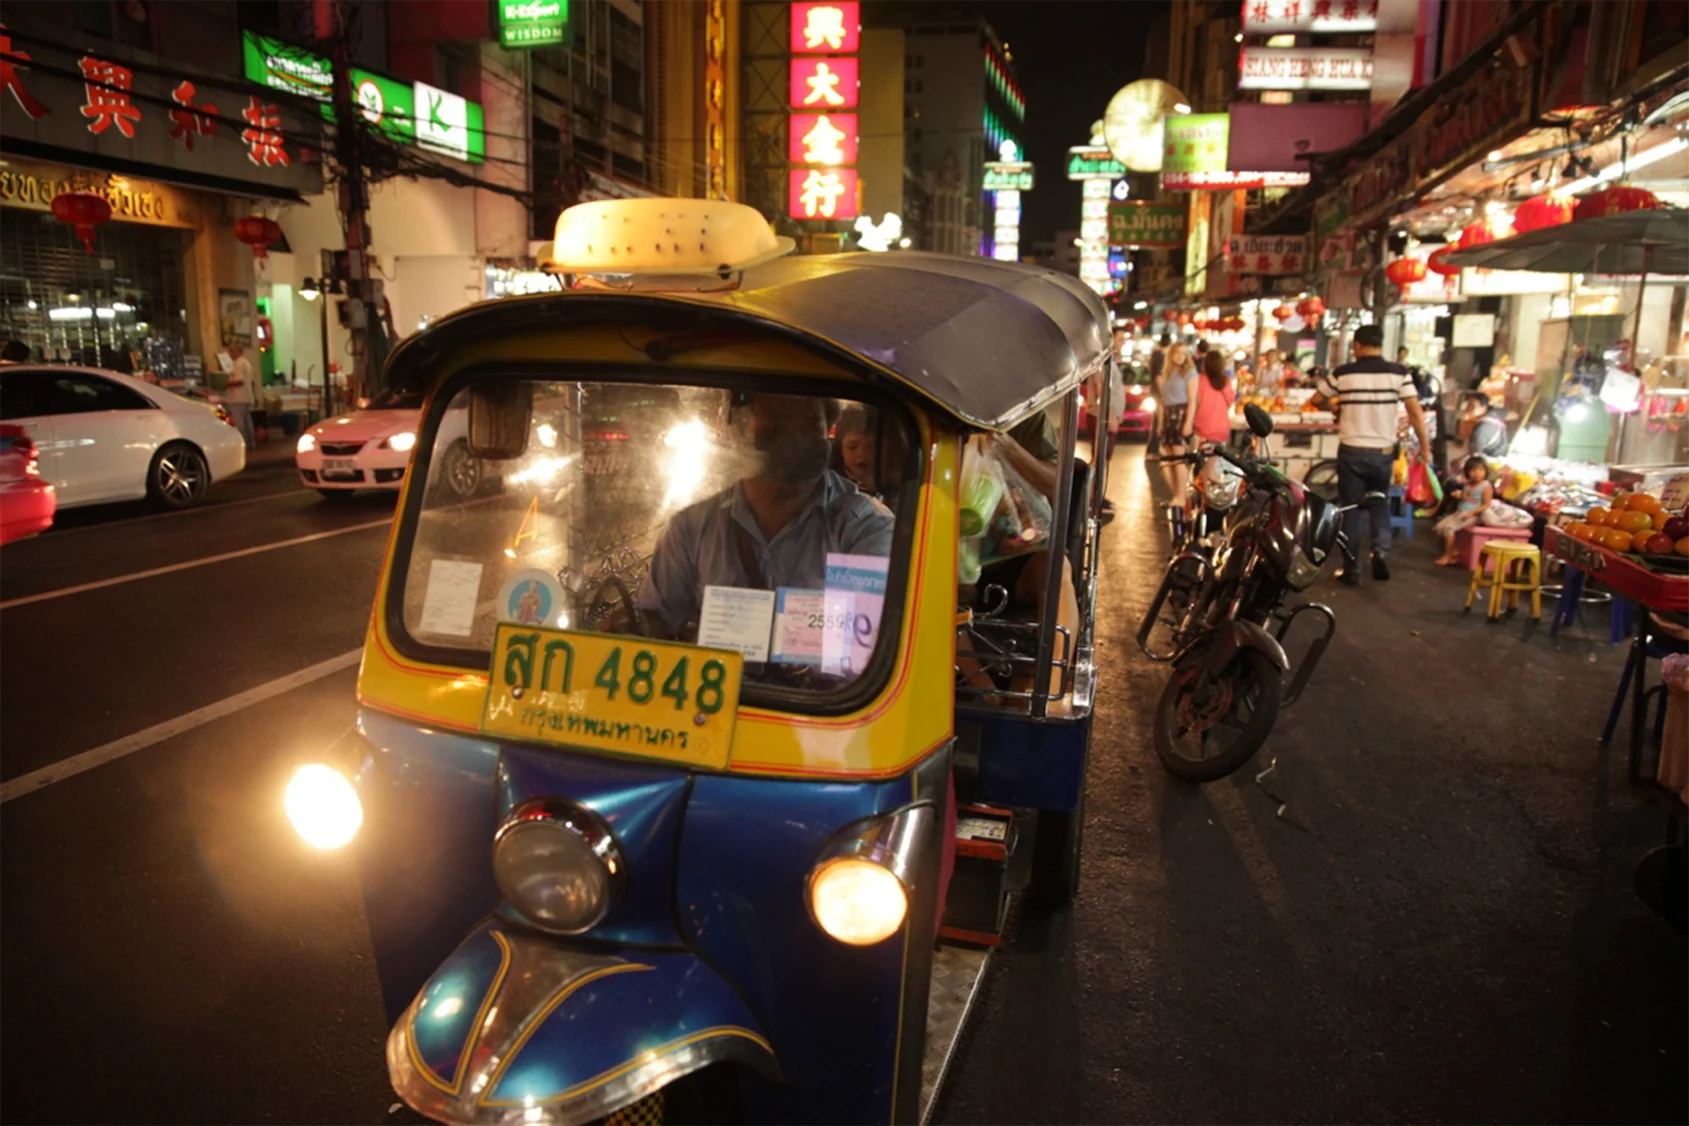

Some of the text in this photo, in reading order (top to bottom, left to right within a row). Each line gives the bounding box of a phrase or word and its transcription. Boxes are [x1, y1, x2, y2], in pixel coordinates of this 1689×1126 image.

[505, 27, 563, 40] WISDOM
[1245, 57, 1285, 77] SIANG
[1289, 57, 1325, 78] HENG
[594, 646, 727, 715] 4848
[521, 706, 689, 749] กรุงเทพมหานคร
